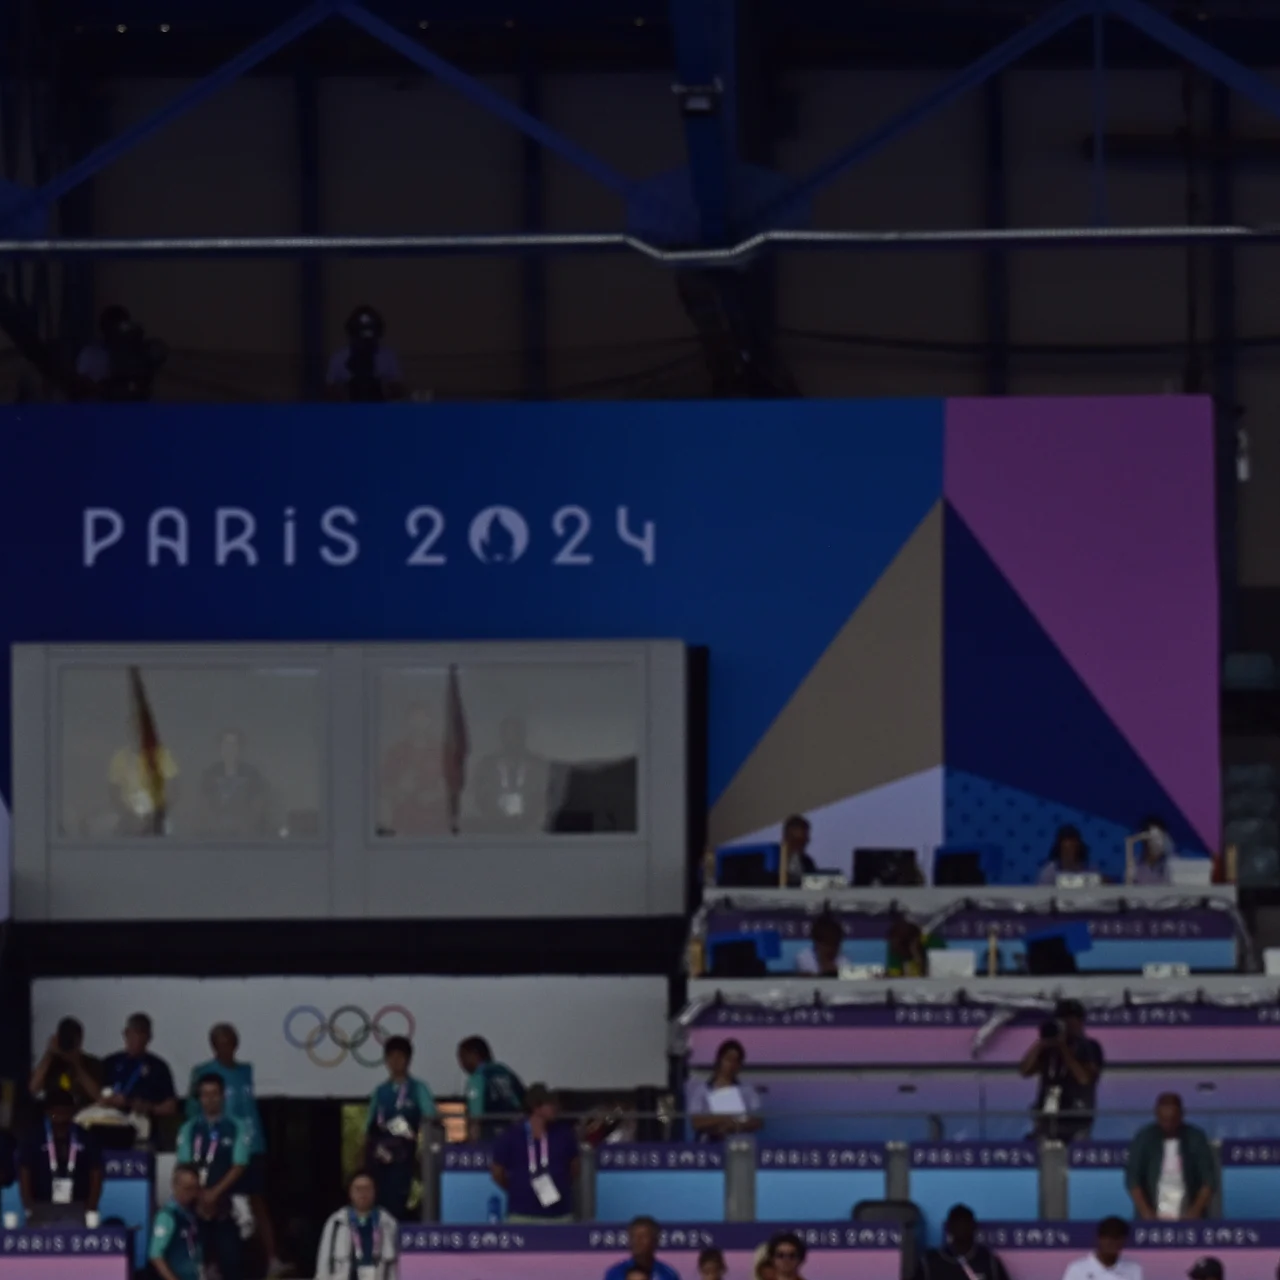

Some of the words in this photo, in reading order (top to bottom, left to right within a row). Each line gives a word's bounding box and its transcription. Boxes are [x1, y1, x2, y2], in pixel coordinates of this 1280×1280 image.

[83, 506, 361, 567] PARIS
[404, 505, 655, 567] 2024
[791, 1229, 841, 1246] ARIS
